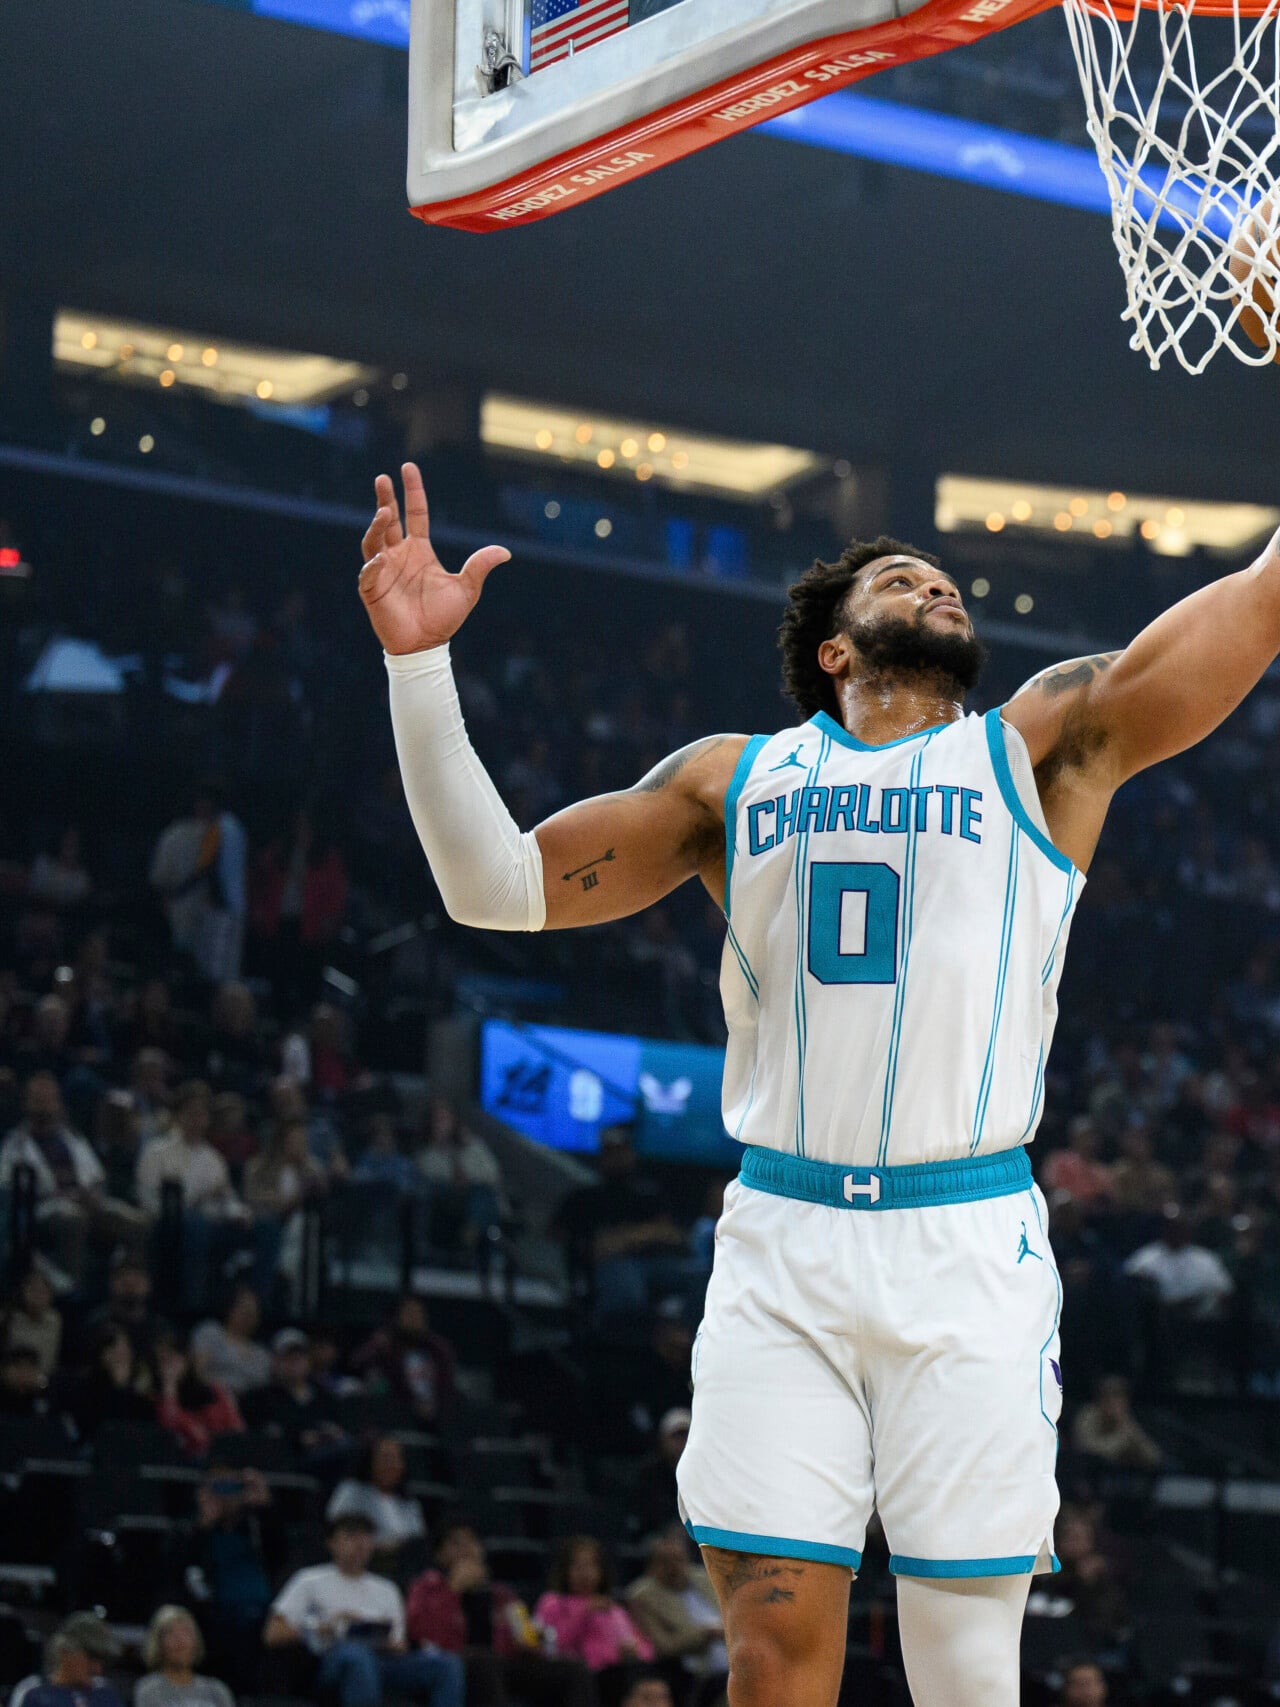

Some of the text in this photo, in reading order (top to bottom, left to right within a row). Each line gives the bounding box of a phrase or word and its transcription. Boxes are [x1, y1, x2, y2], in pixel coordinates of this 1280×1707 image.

[959, 0, 1014, 23] HE
[712, 50, 897, 122] HERDEZ SALSA
[485, 150, 656, 221] HERDEZ SALSA
[747, 783, 983, 857] CHARLOTTE
[808, 862, 900, 986] 0
